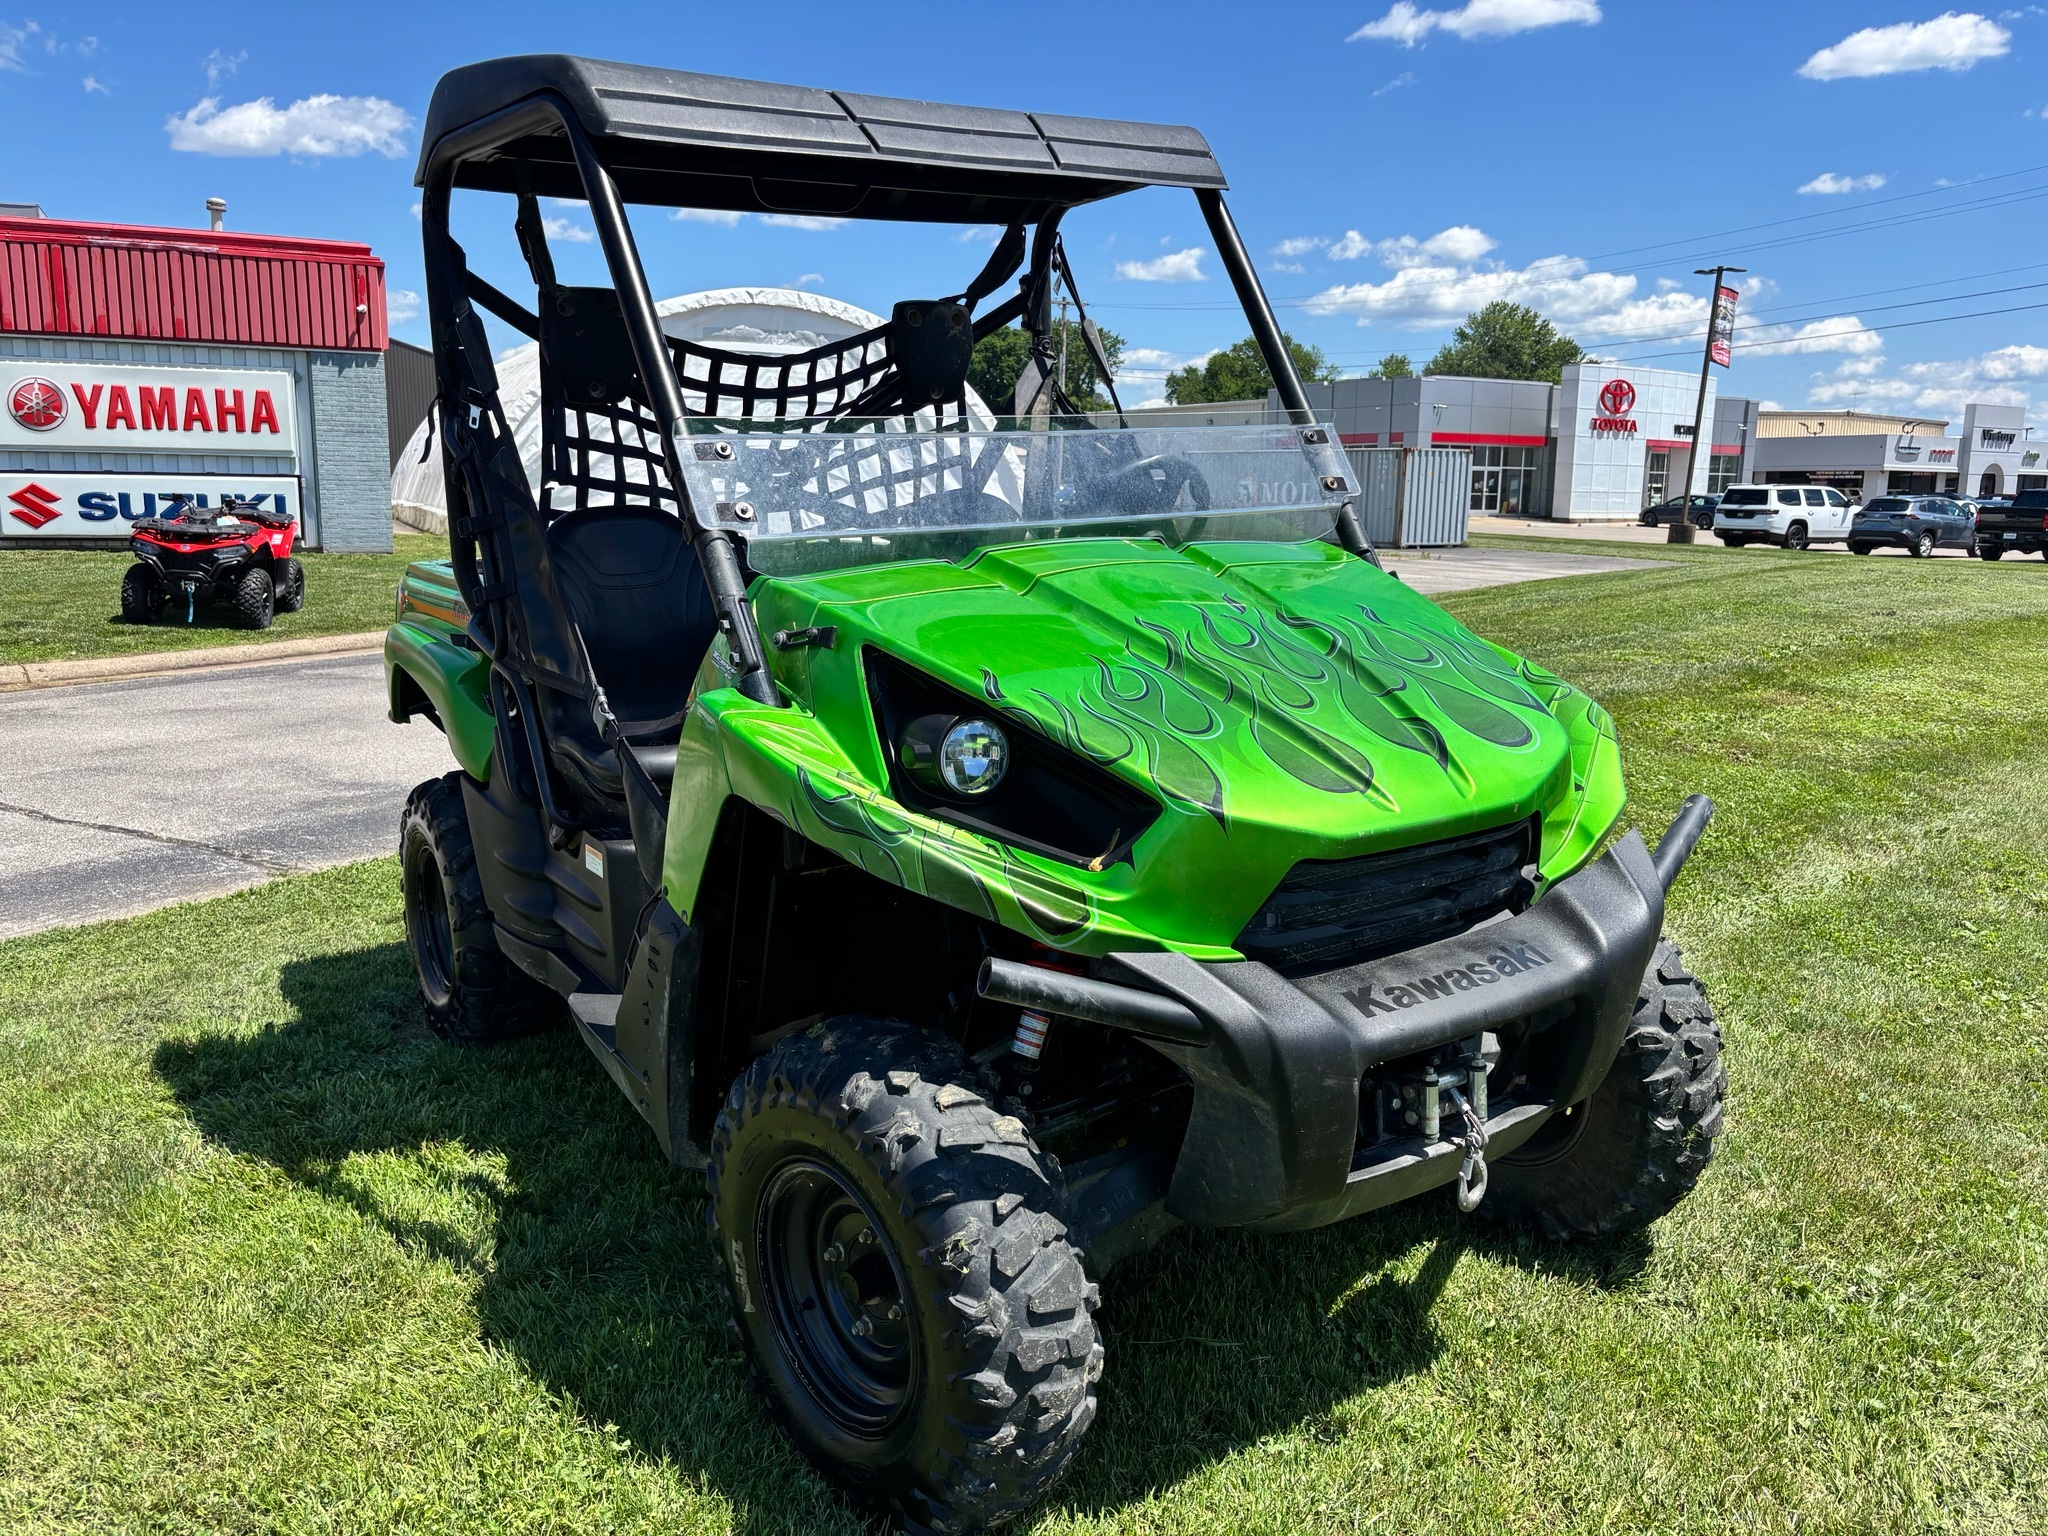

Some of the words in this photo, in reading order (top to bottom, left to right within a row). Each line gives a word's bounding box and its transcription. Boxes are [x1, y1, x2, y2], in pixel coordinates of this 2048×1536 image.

[71, 382, 281, 434] YAMAHA
[1591, 418, 1637, 432] TOYOTA
[1262, 481, 1314, 504] MOL
[1341, 940, 1553, 1018] Kawasaki
